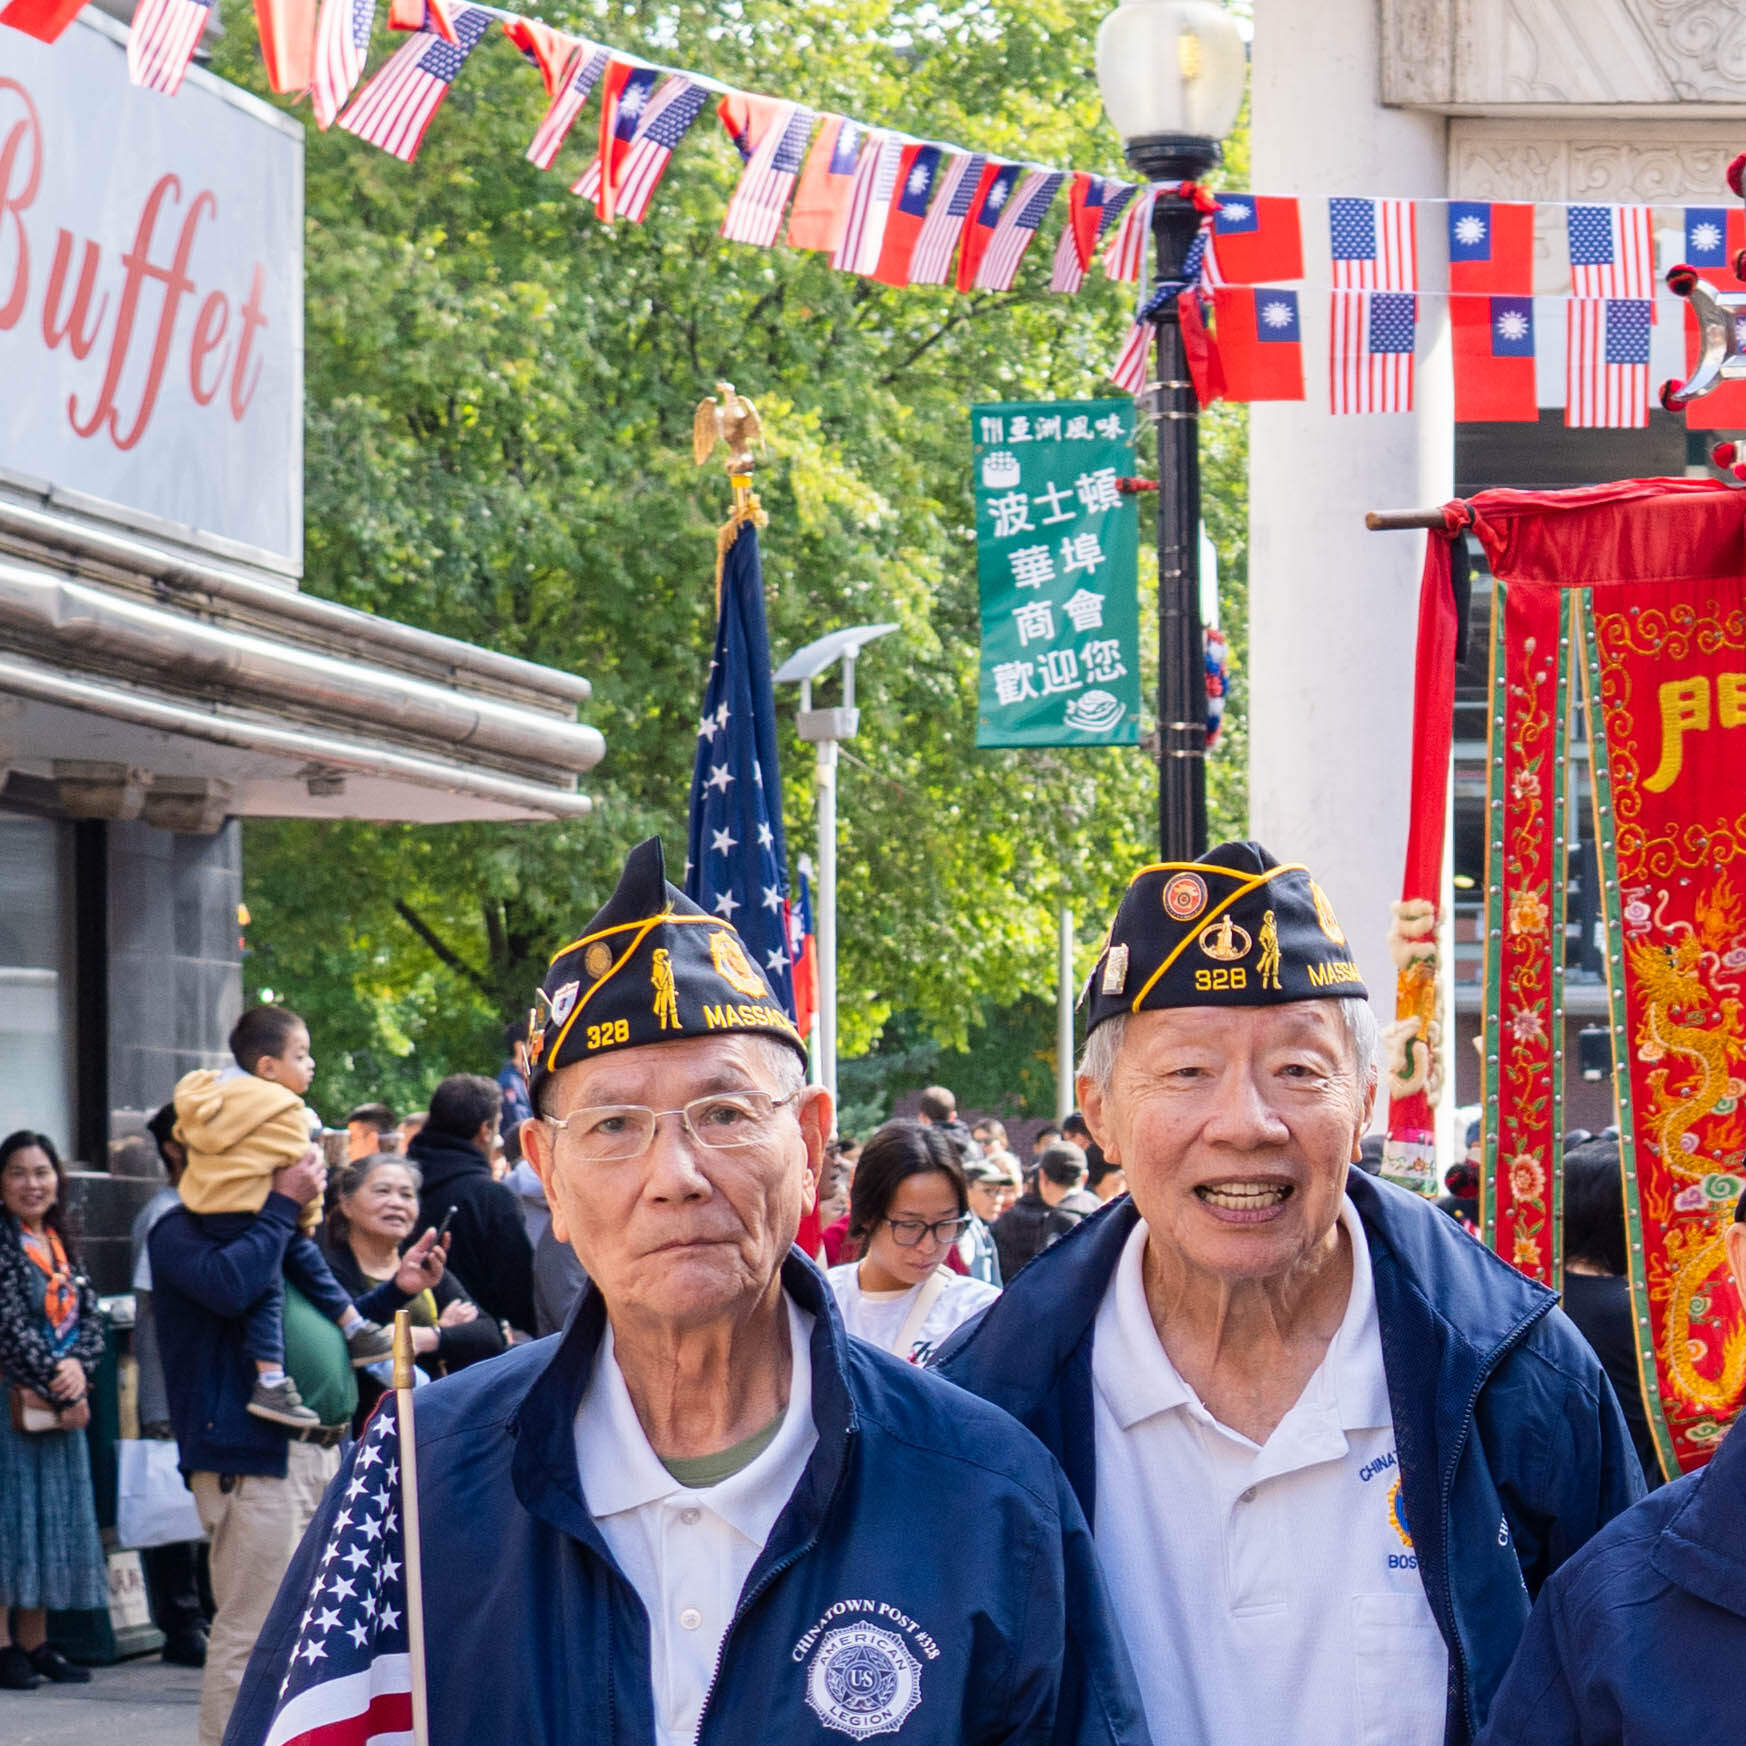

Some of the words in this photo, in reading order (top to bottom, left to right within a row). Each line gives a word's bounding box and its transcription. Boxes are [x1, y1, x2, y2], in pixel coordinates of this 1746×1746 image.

[1008, 413, 1126, 443] 亞洲風味
[987, 467, 1124, 537] 波士頓
[1008, 533, 1106, 588] 華埠
[1012, 588, 1106, 646] 商會
[992, 639, 1128, 705] 歡迎您
[1195, 967, 1248, 991] 328
[586, 1019, 630, 1049] 328
[792, 1599, 876, 1662] CHINATOWN
[877, 1602, 921, 1635] POST
[914, 1630, 942, 1661] #328
[820, 1633, 907, 1672] AMERICAN
[829, 1704, 894, 1727] LEGION
